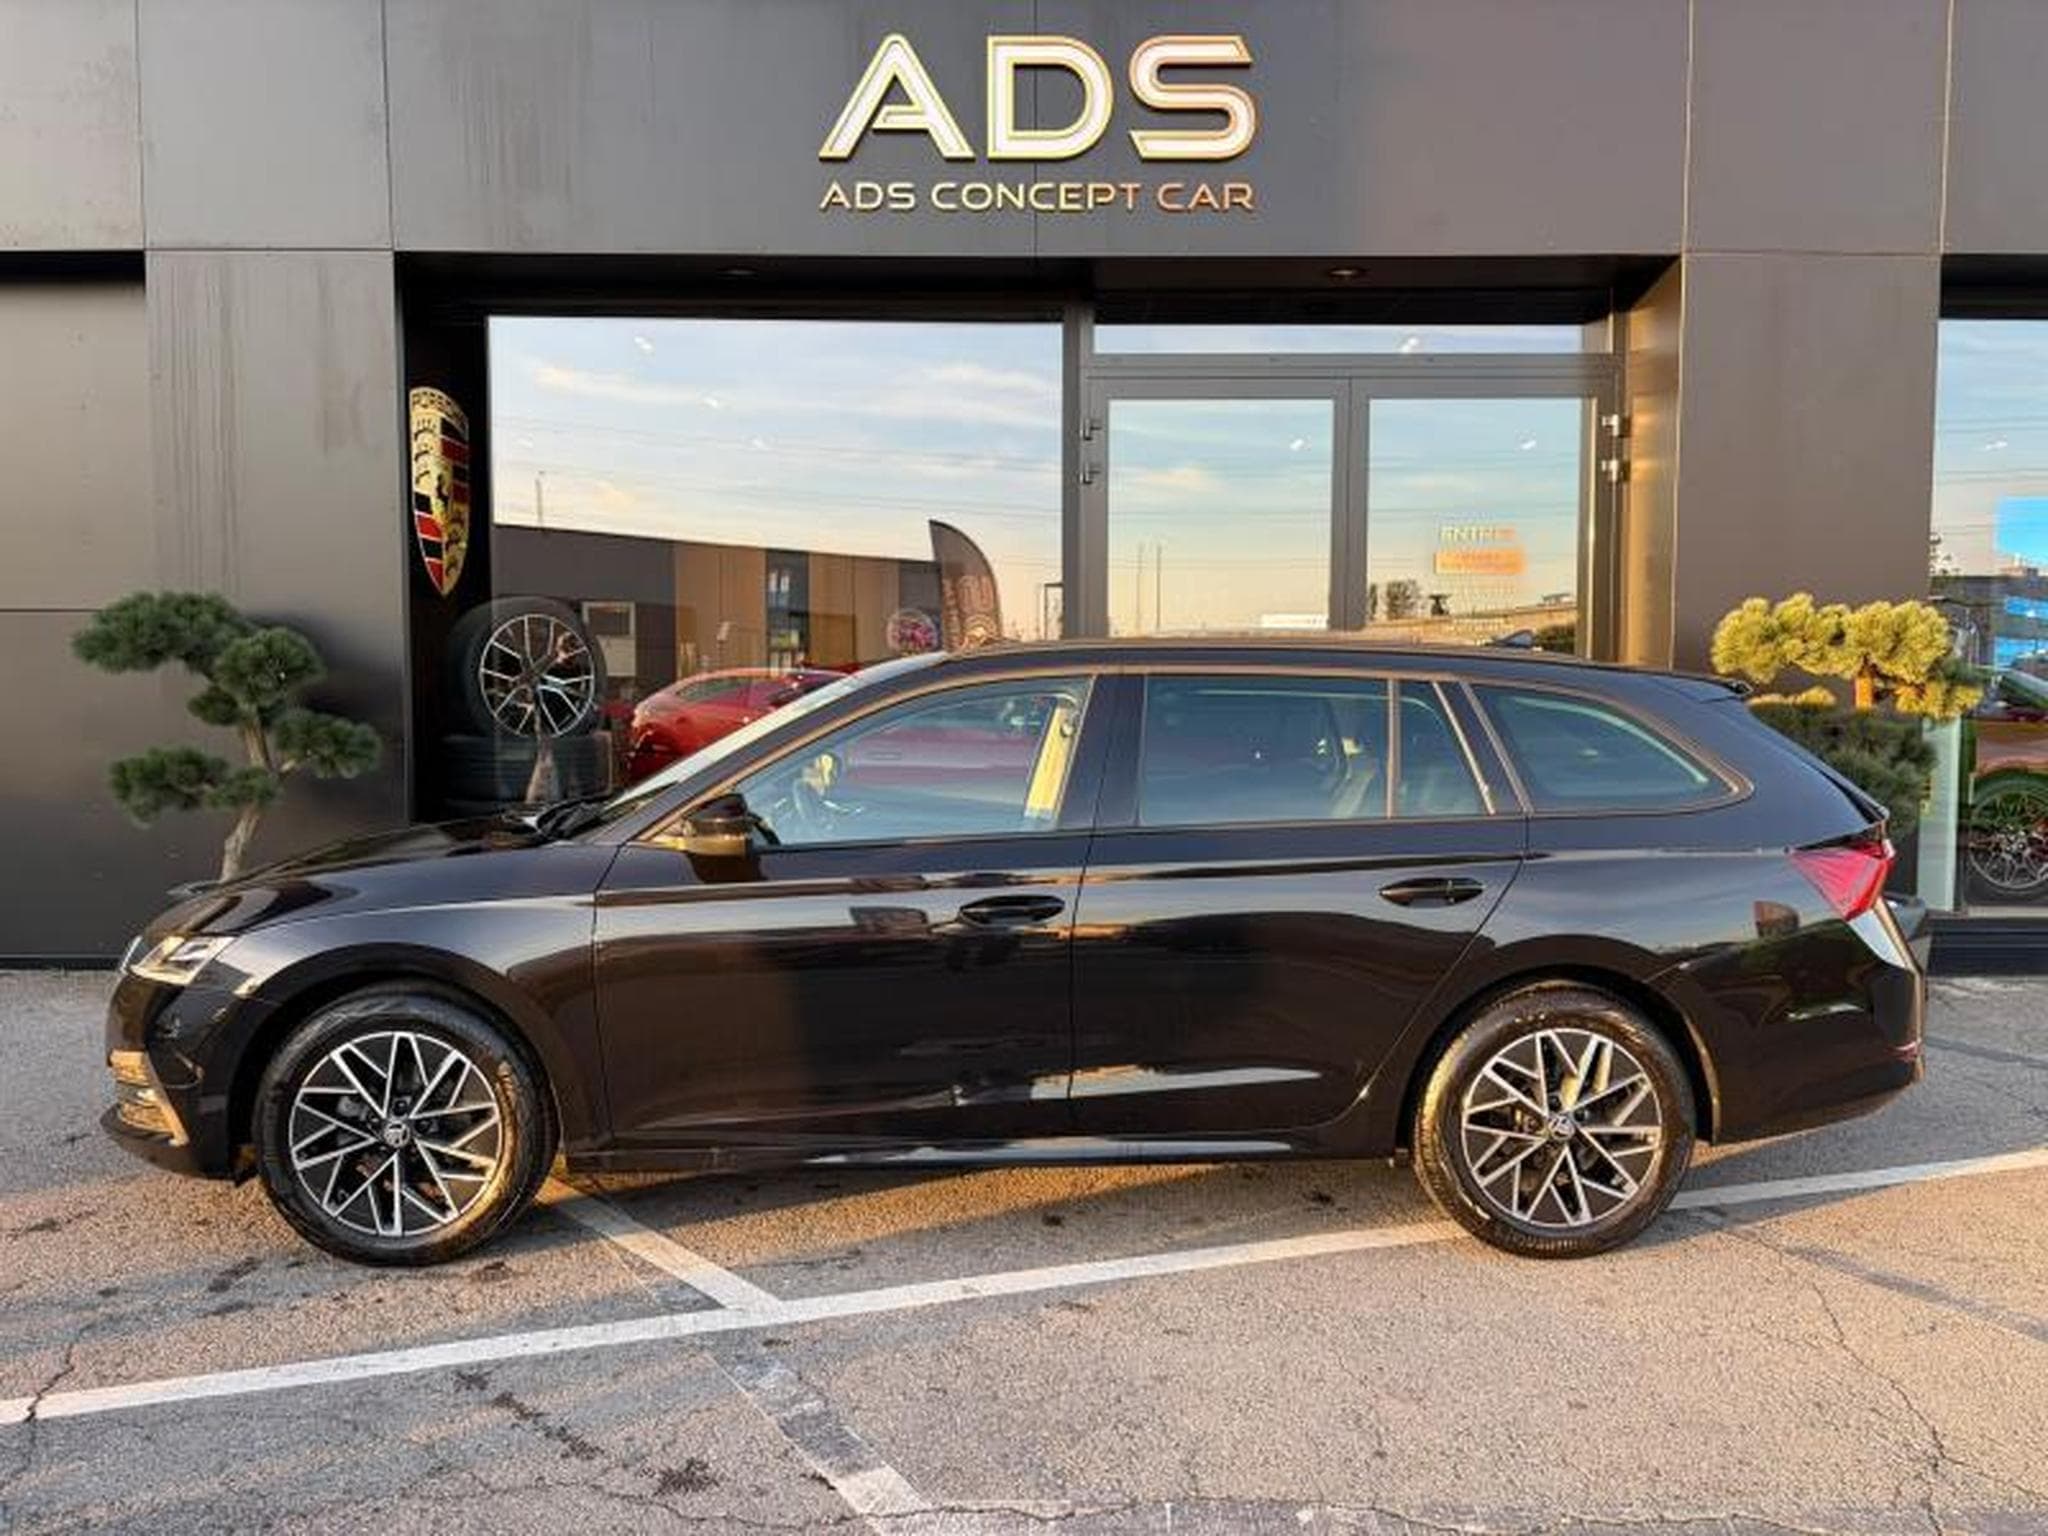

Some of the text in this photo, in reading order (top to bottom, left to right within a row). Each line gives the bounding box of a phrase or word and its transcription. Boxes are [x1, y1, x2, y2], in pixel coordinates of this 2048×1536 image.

[819, 33, 1257, 160] ADS
[819, 182, 1255, 211] ADS CONCEPT CAR
